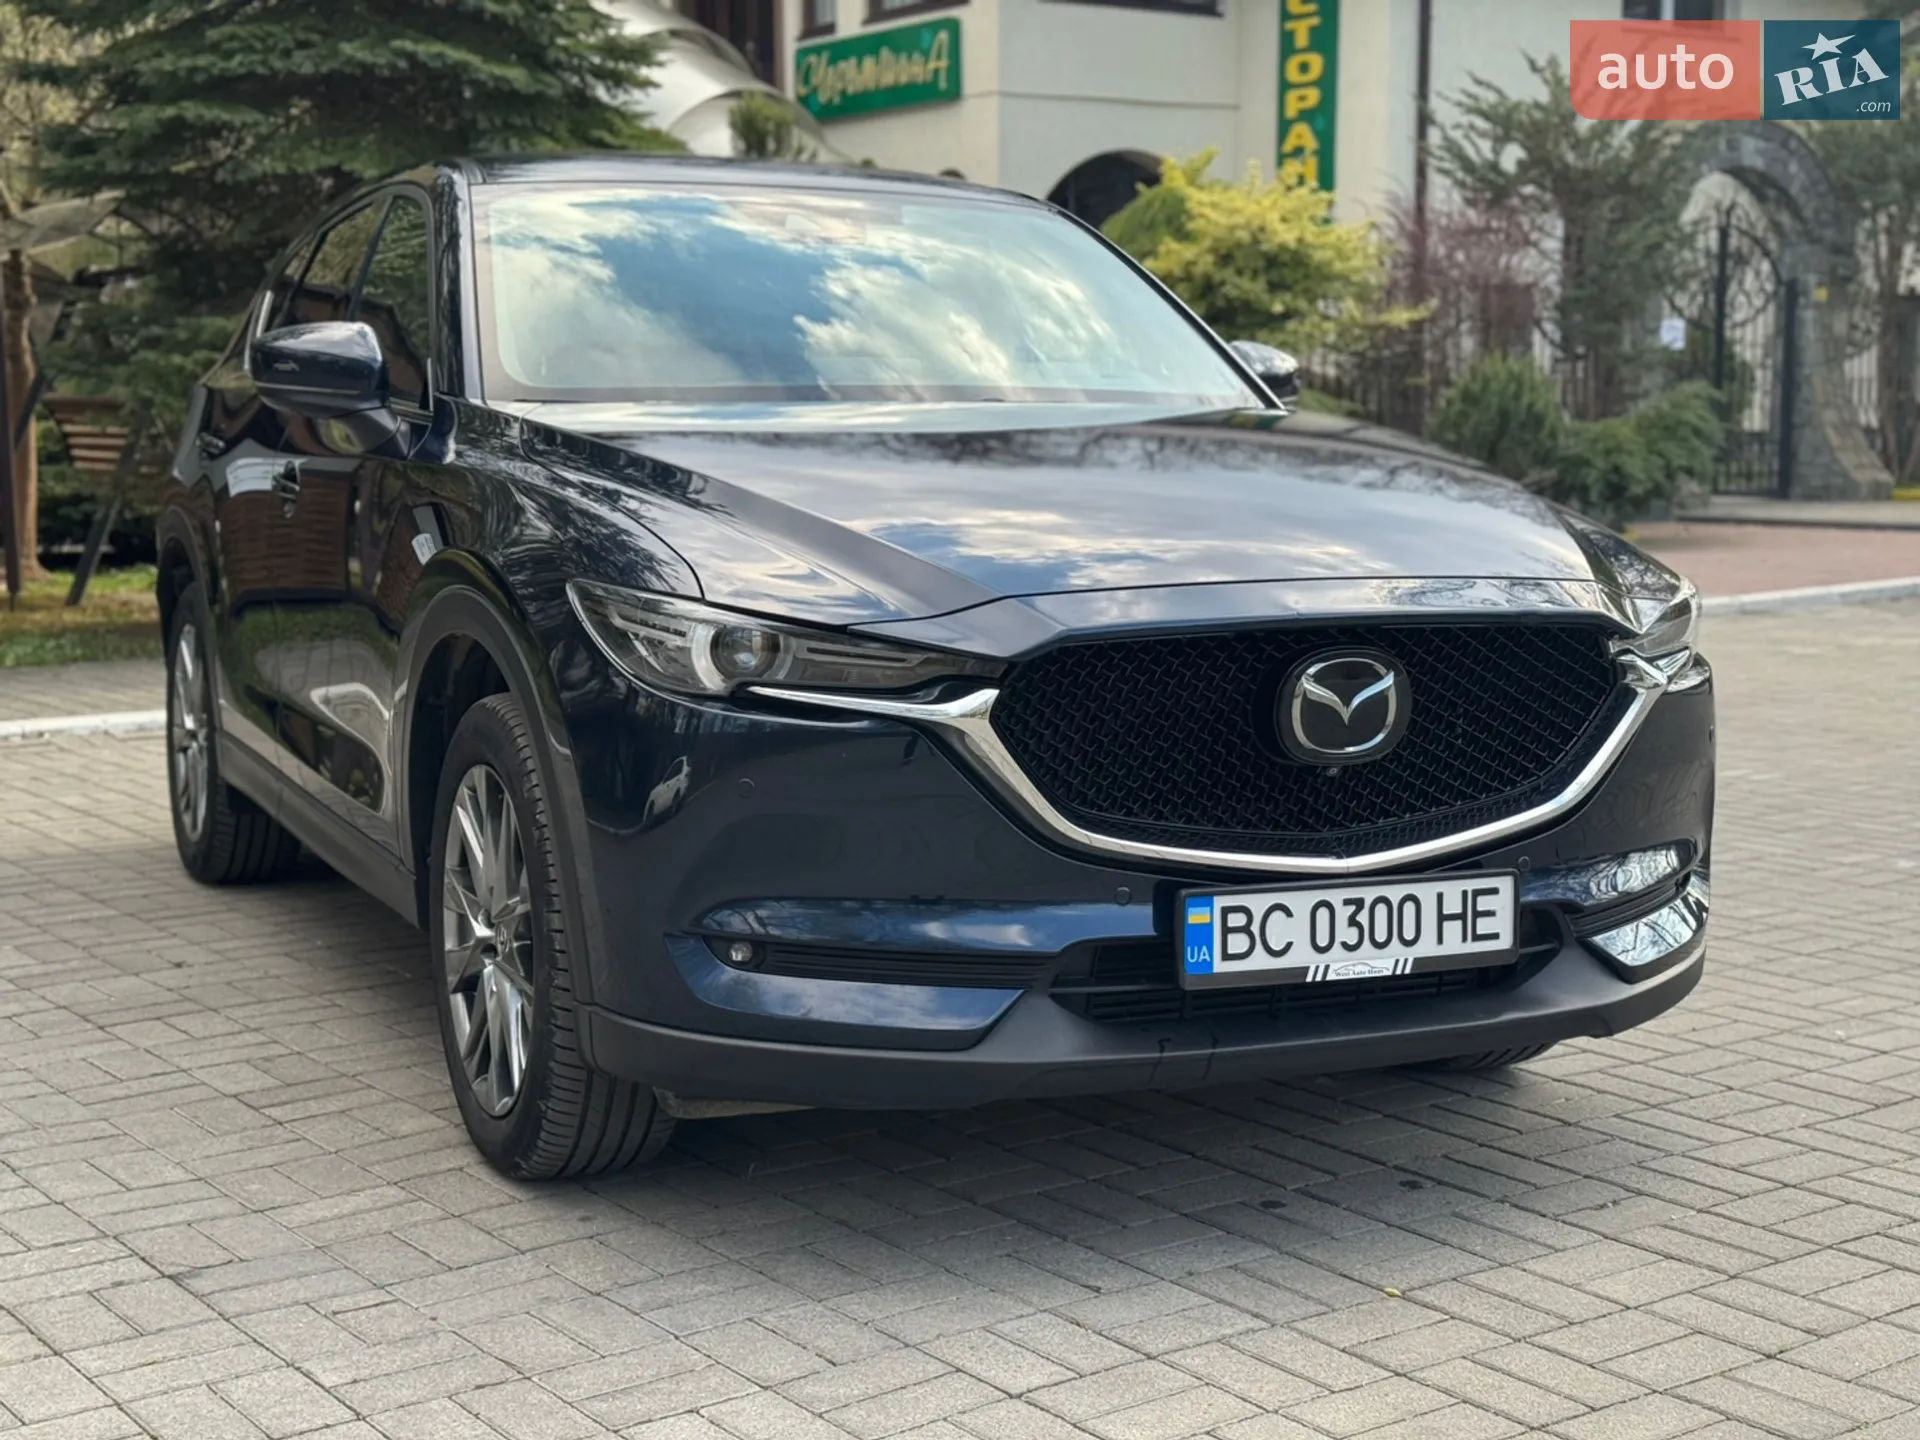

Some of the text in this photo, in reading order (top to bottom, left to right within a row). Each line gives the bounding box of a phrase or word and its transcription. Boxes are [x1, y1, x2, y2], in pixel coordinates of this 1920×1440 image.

[1220, 886, 1501, 962] BC 0300 HE
[1187, 945, 1211, 963] UA
